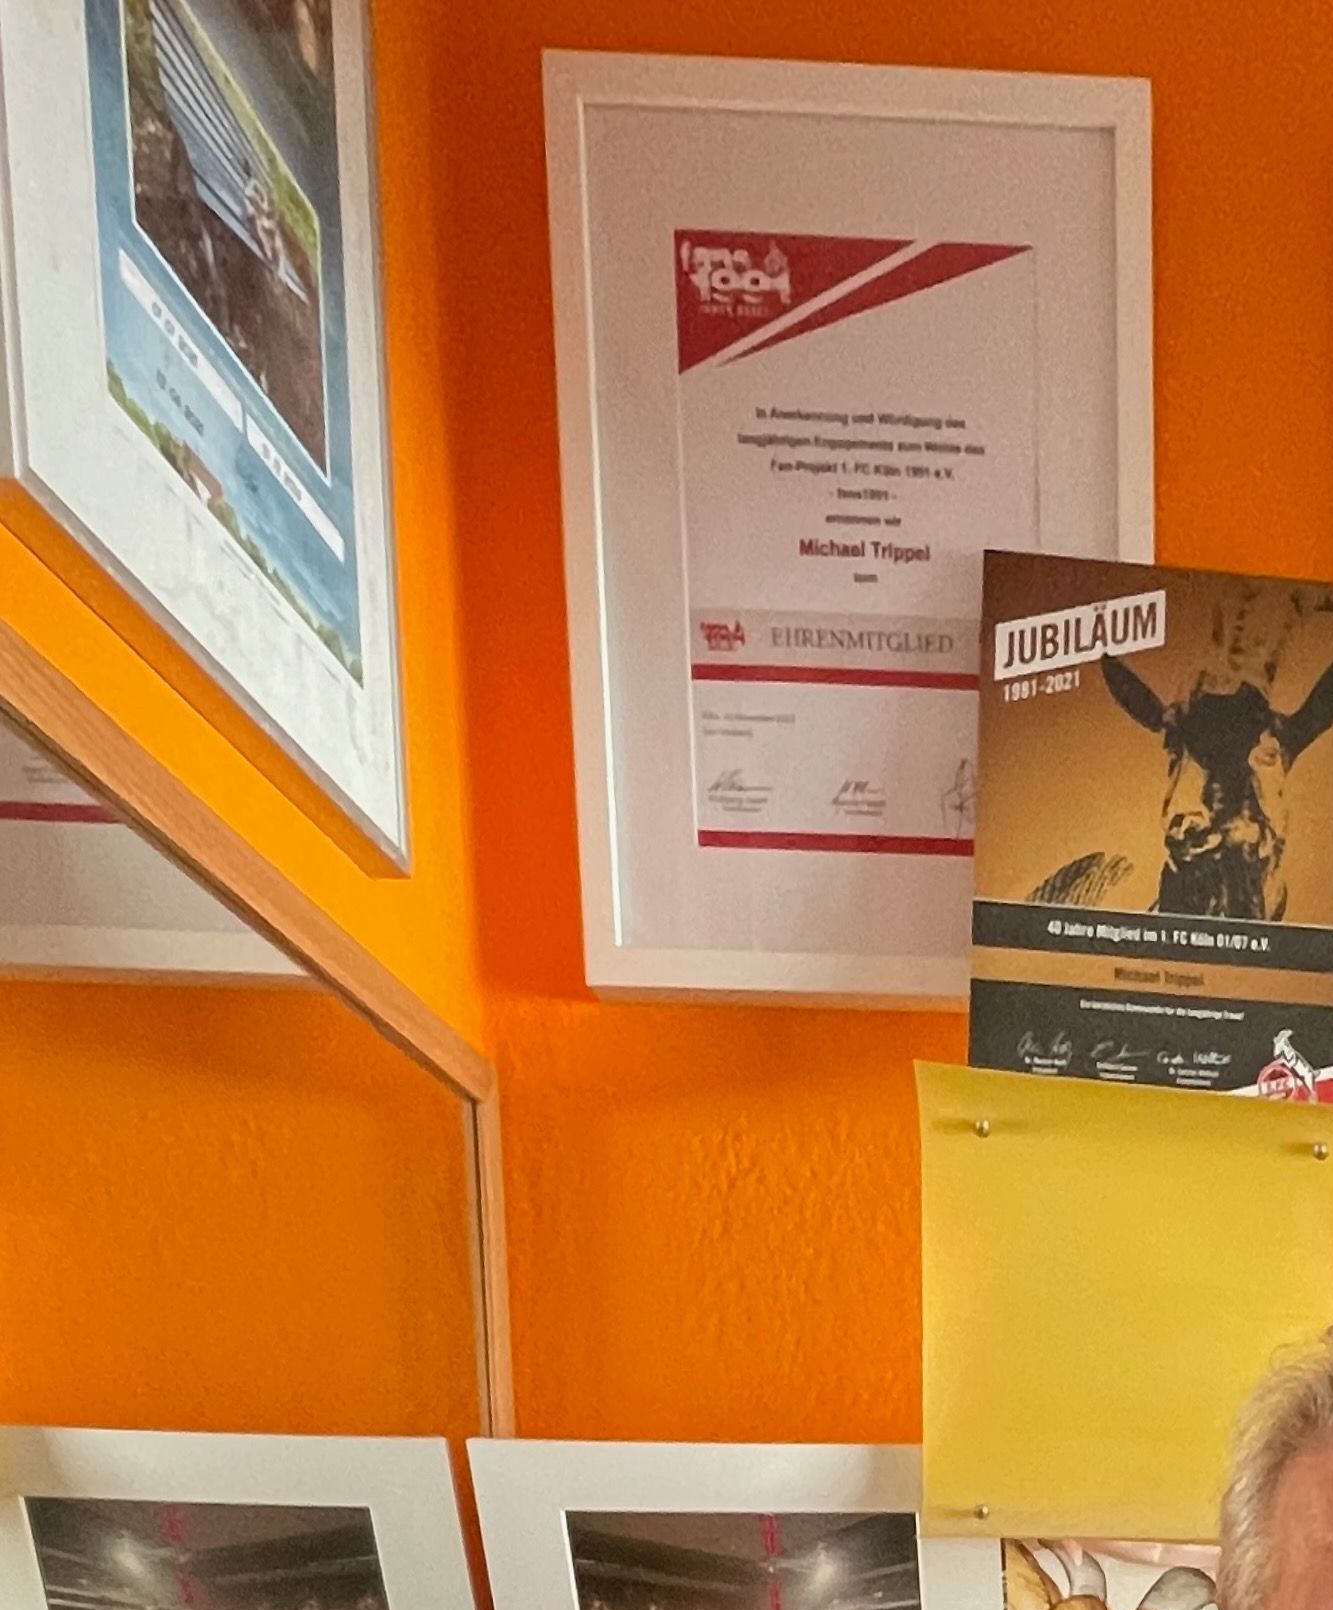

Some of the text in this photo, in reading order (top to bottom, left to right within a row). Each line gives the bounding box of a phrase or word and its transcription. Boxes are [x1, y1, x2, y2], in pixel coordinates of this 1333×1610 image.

[800, 539, 930, 564] Michael Trippel
[771, 627, 954, 653] EHRENMITGLIED
[1003, 602, 1157, 669] JUBILÄUM
[1173, 930, 1187, 946] FC
